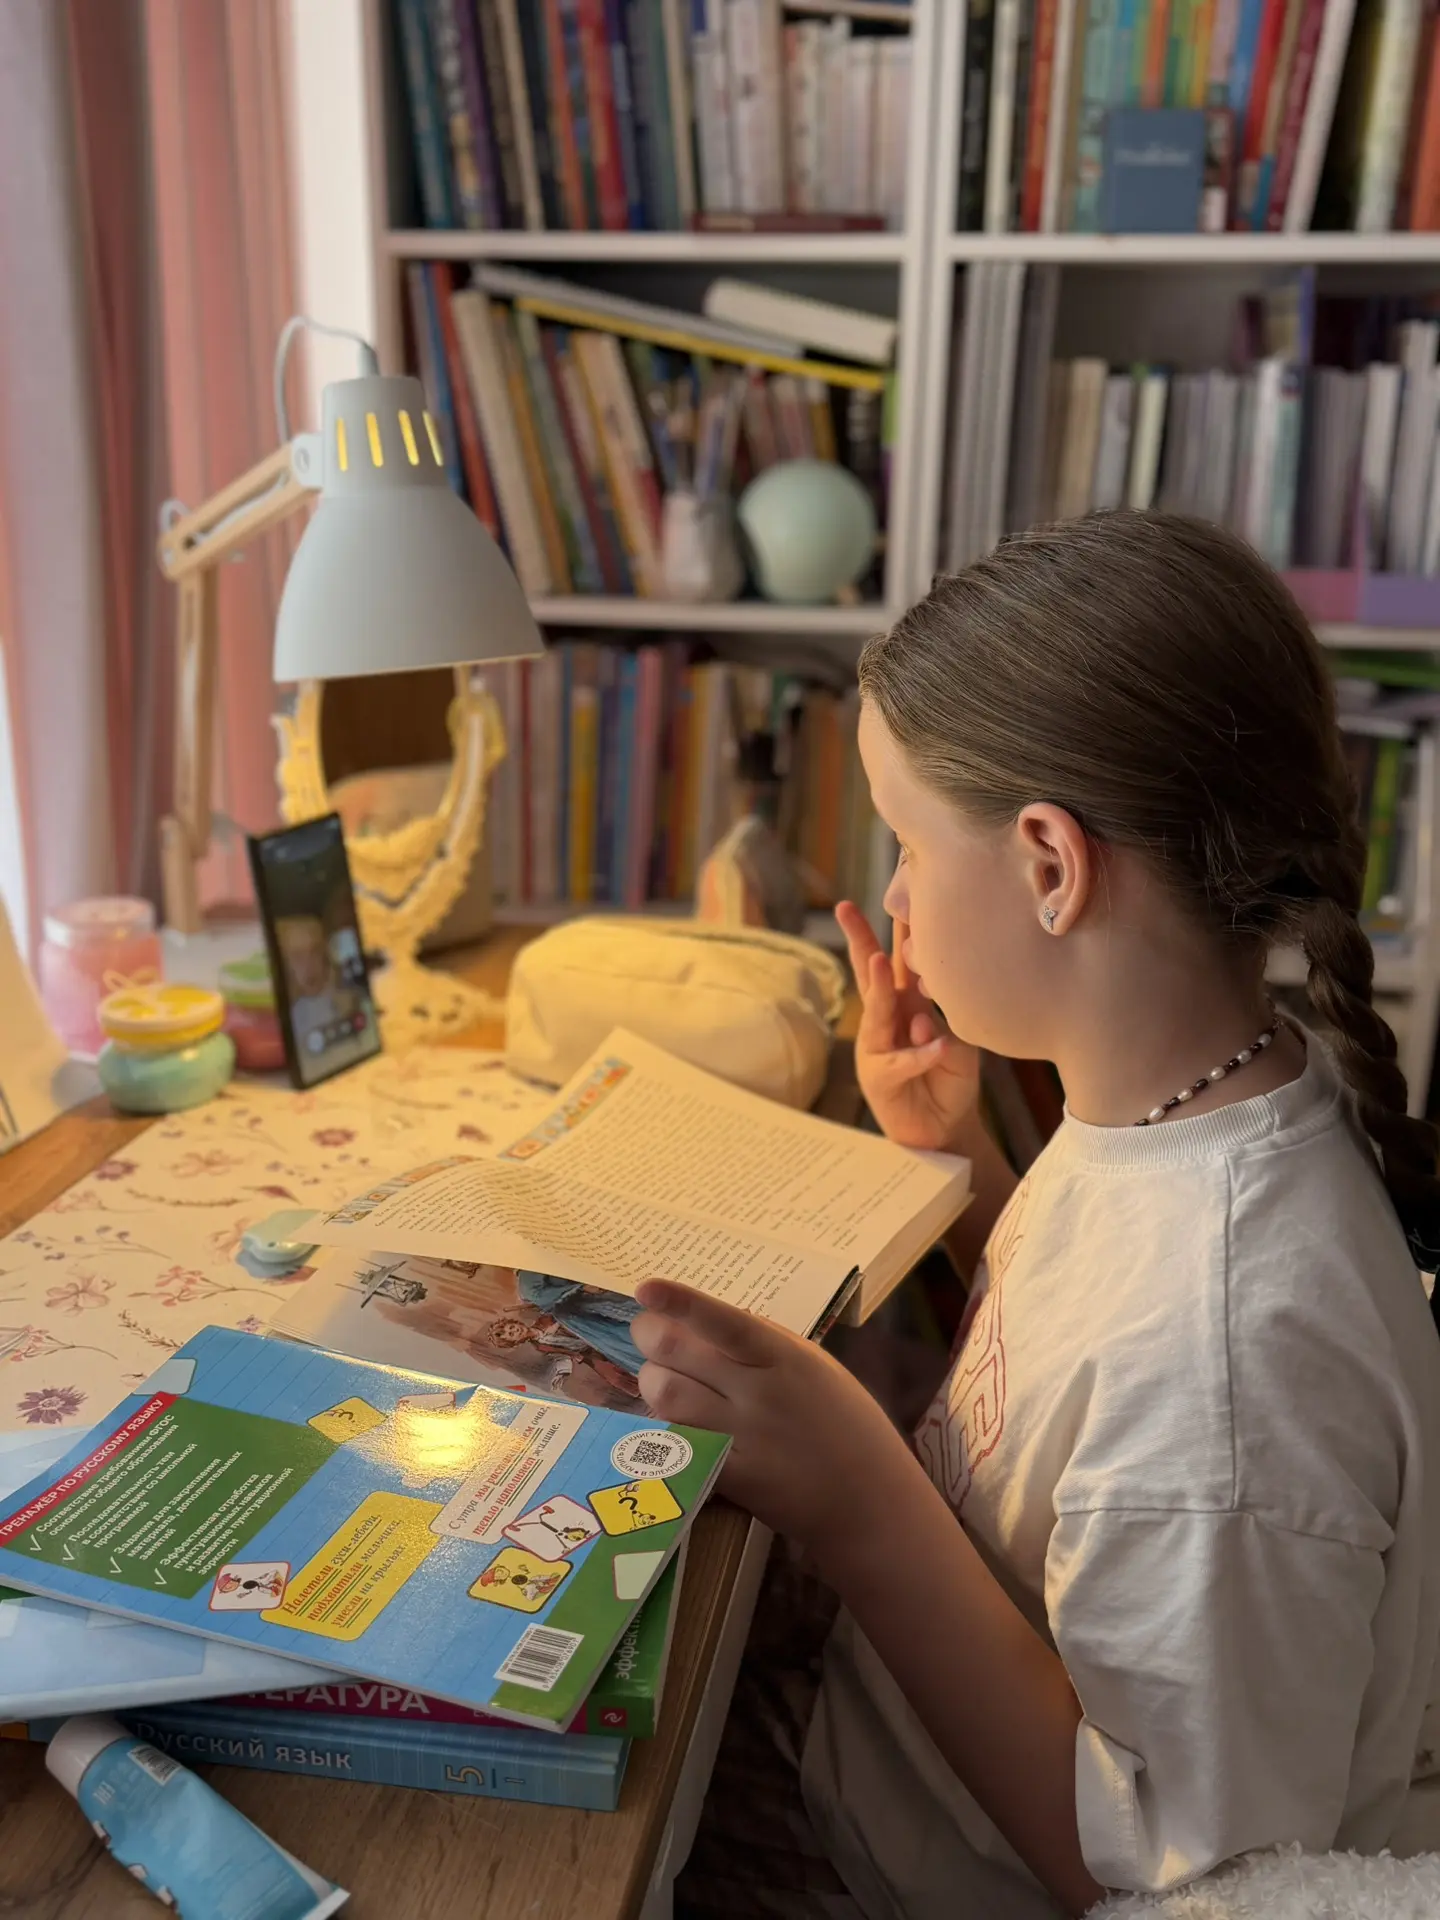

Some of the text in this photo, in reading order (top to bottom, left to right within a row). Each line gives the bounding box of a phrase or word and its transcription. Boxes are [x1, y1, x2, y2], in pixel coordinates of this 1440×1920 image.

[36, 1415, 174, 1532] Соответствие требованиям ФГОС
[50, 1425, 178, 1535] основного общего образования
[56, 1479, 76, 1491] ПО
[73, 1431, 129, 1478] РУССКОМУ
[128, 1400, 162, 1430] ЯЗЫКУ
[449, 1521, 460, 1529] С
[456, 1500, 478, 1523] утра
[475, 1485, 490, 1499] мы
[532, 1407, 550, 1425] очаг,
[473, 1424, 560, 1534] тепло наполняет жилище.
[617, 1440, 630, 1451] ЭТУ
[629, 1432, 656, 1442] КНИГУ
[648, 1444, 686, 1476] ЭЛЕКТРОННОМ
[68, 1452, 175, 1541] Последовательность тем
[89, 1490, 148, 1539] соответствии
[146, 1480, 158, 1489] со
[156, 1444, 197, 1479] школьной
[94, 1502, 149, 1548] программой
[114, 1459, 221, 1554] Задания для закрепления
[127, 1452, 242, 1556] материала, дополнительных
[160, 1474, 259, 1565] Эффективная отработка
[173, 1474, 273, 1568] пунктуационных навыков
[183, 1468, 293, 1572] и развитие пунктуационной
[140, 1529, 176, 1560] занятий
[198, 1539, 238, 1574] зоркости
[281, 1515, 382, 1614] Налетели гуси-лебеди,
[307, 1562, 363, 1621] подхватили
[331, 1596, 363, 1627] унесли
[360, 1583, 373, 1594] на
[275, 1745, 352, 1769] язык
